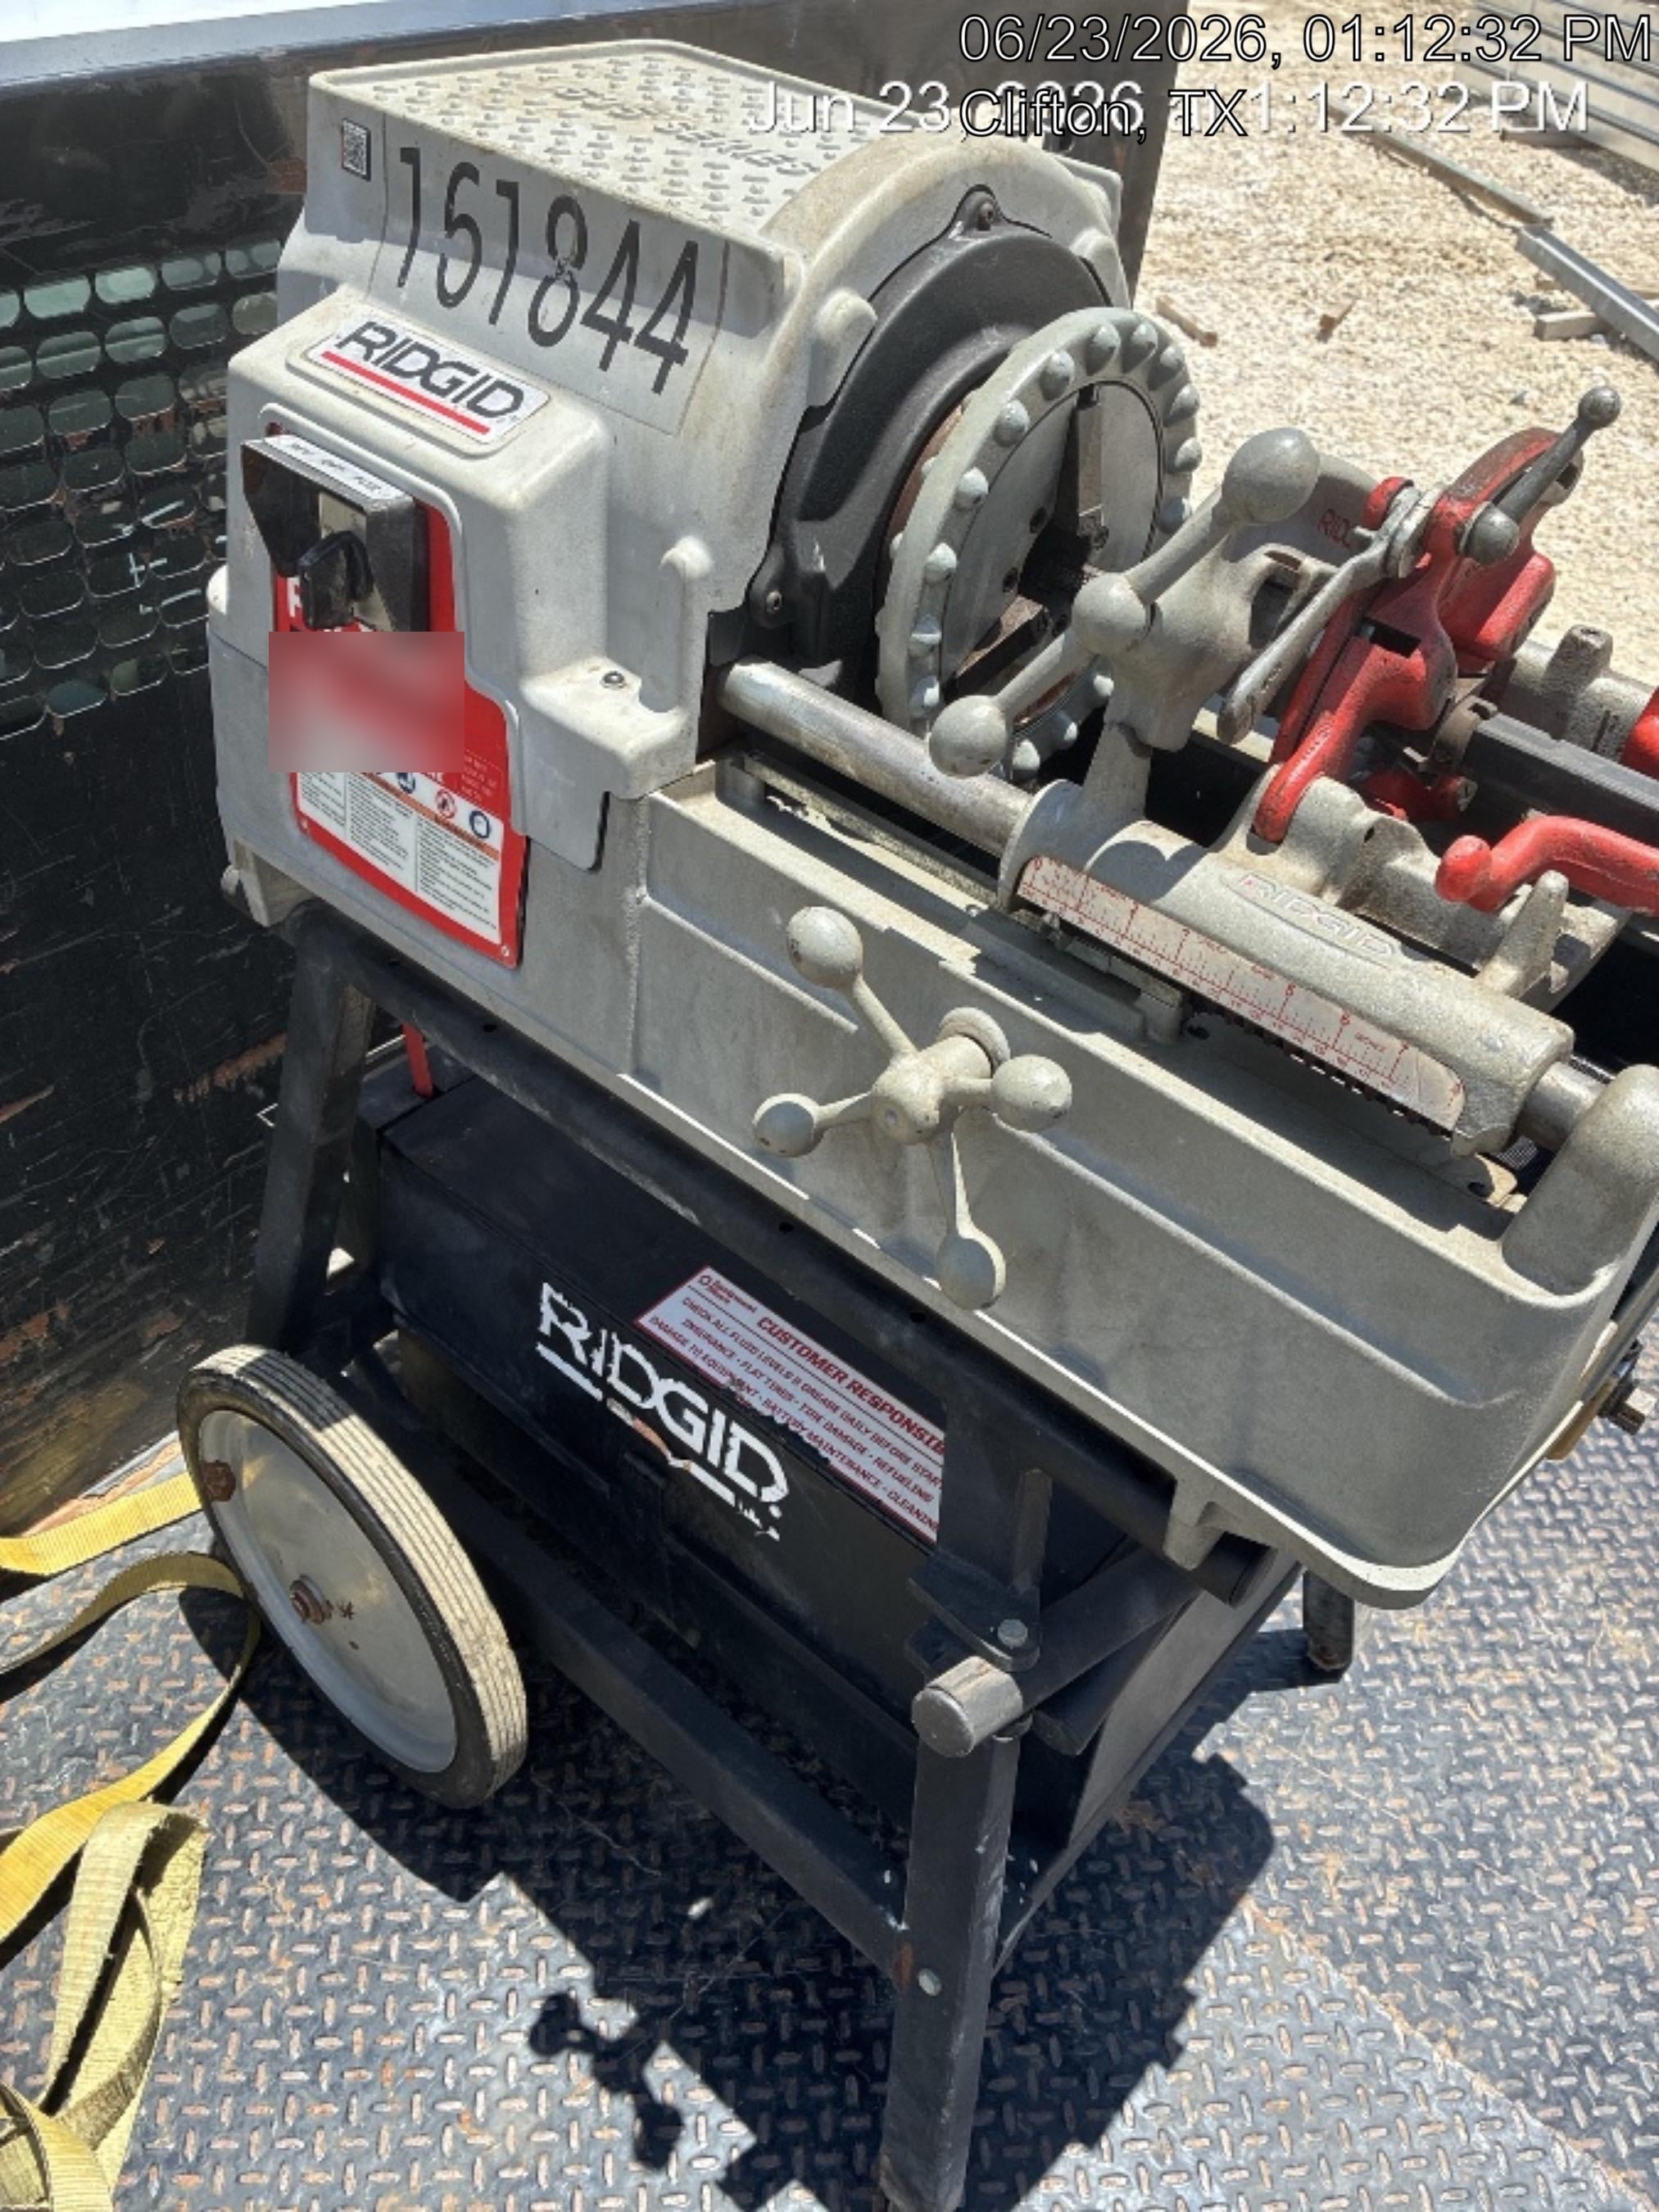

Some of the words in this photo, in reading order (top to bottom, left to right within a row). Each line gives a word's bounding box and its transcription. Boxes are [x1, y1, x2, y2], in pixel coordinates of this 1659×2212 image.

[397, 147, 698, 397] 161844
[334, 320, 524, 419] RIDGID
[537, 1282, 789, 1503] RIDGID
[712, 1320, 729, 1334] ALL
[870, 1433, 912, 1464] BEFORE
[758, 1317, 848, 1384] CUSTOMER
[800, 1403, 823, 1422] TIRE
[823, 1423, 868, 1454] DAMAGE
